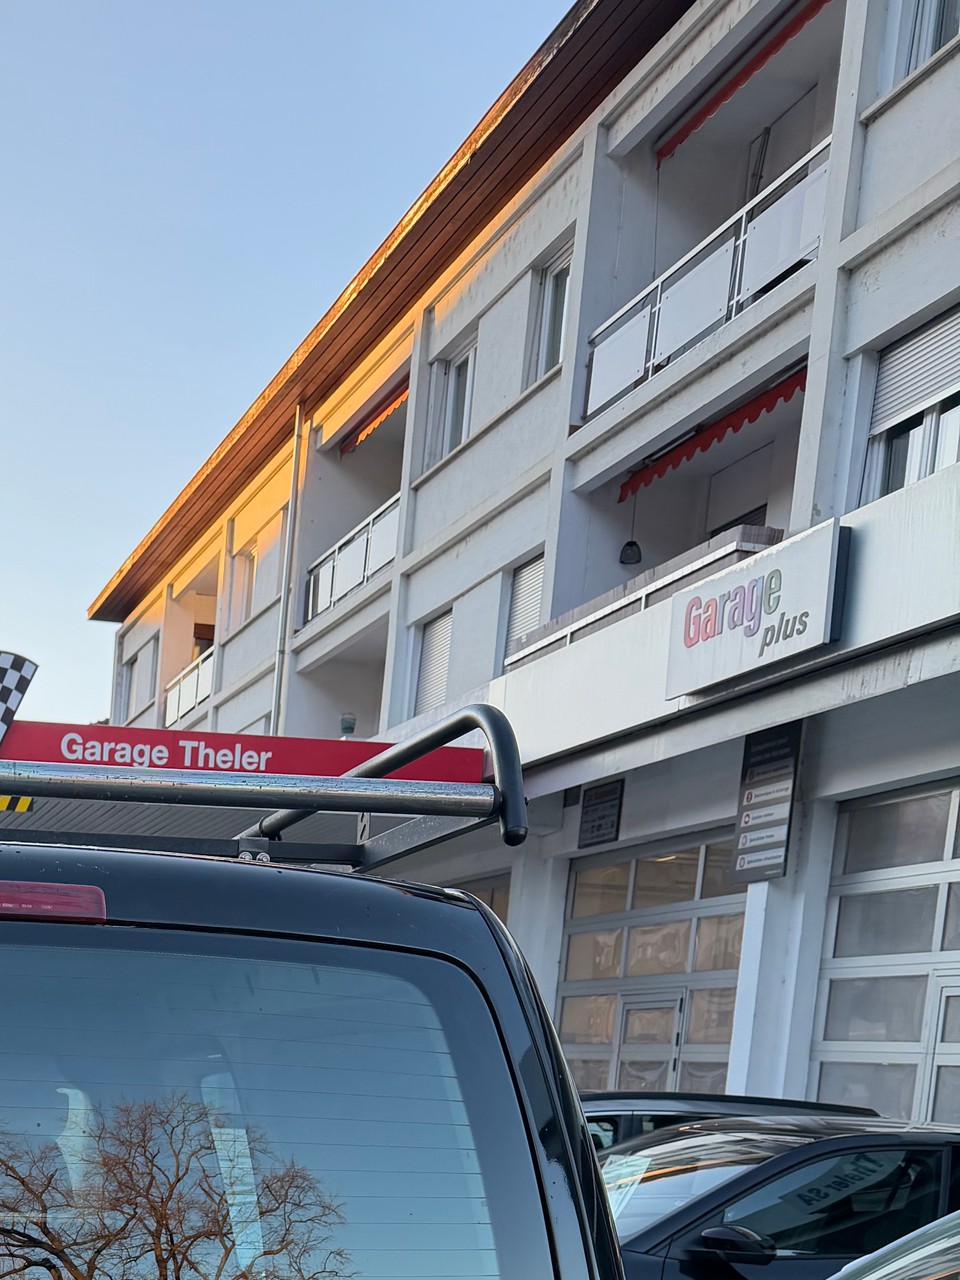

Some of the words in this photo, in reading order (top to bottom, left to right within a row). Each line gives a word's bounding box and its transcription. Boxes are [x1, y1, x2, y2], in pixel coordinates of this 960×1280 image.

[683, 568, 783, 649] Garage
[758, 611, 810, 658] plus
[60, 732, 169, 768] Garage
[178, 740, 272, 771] Theler
